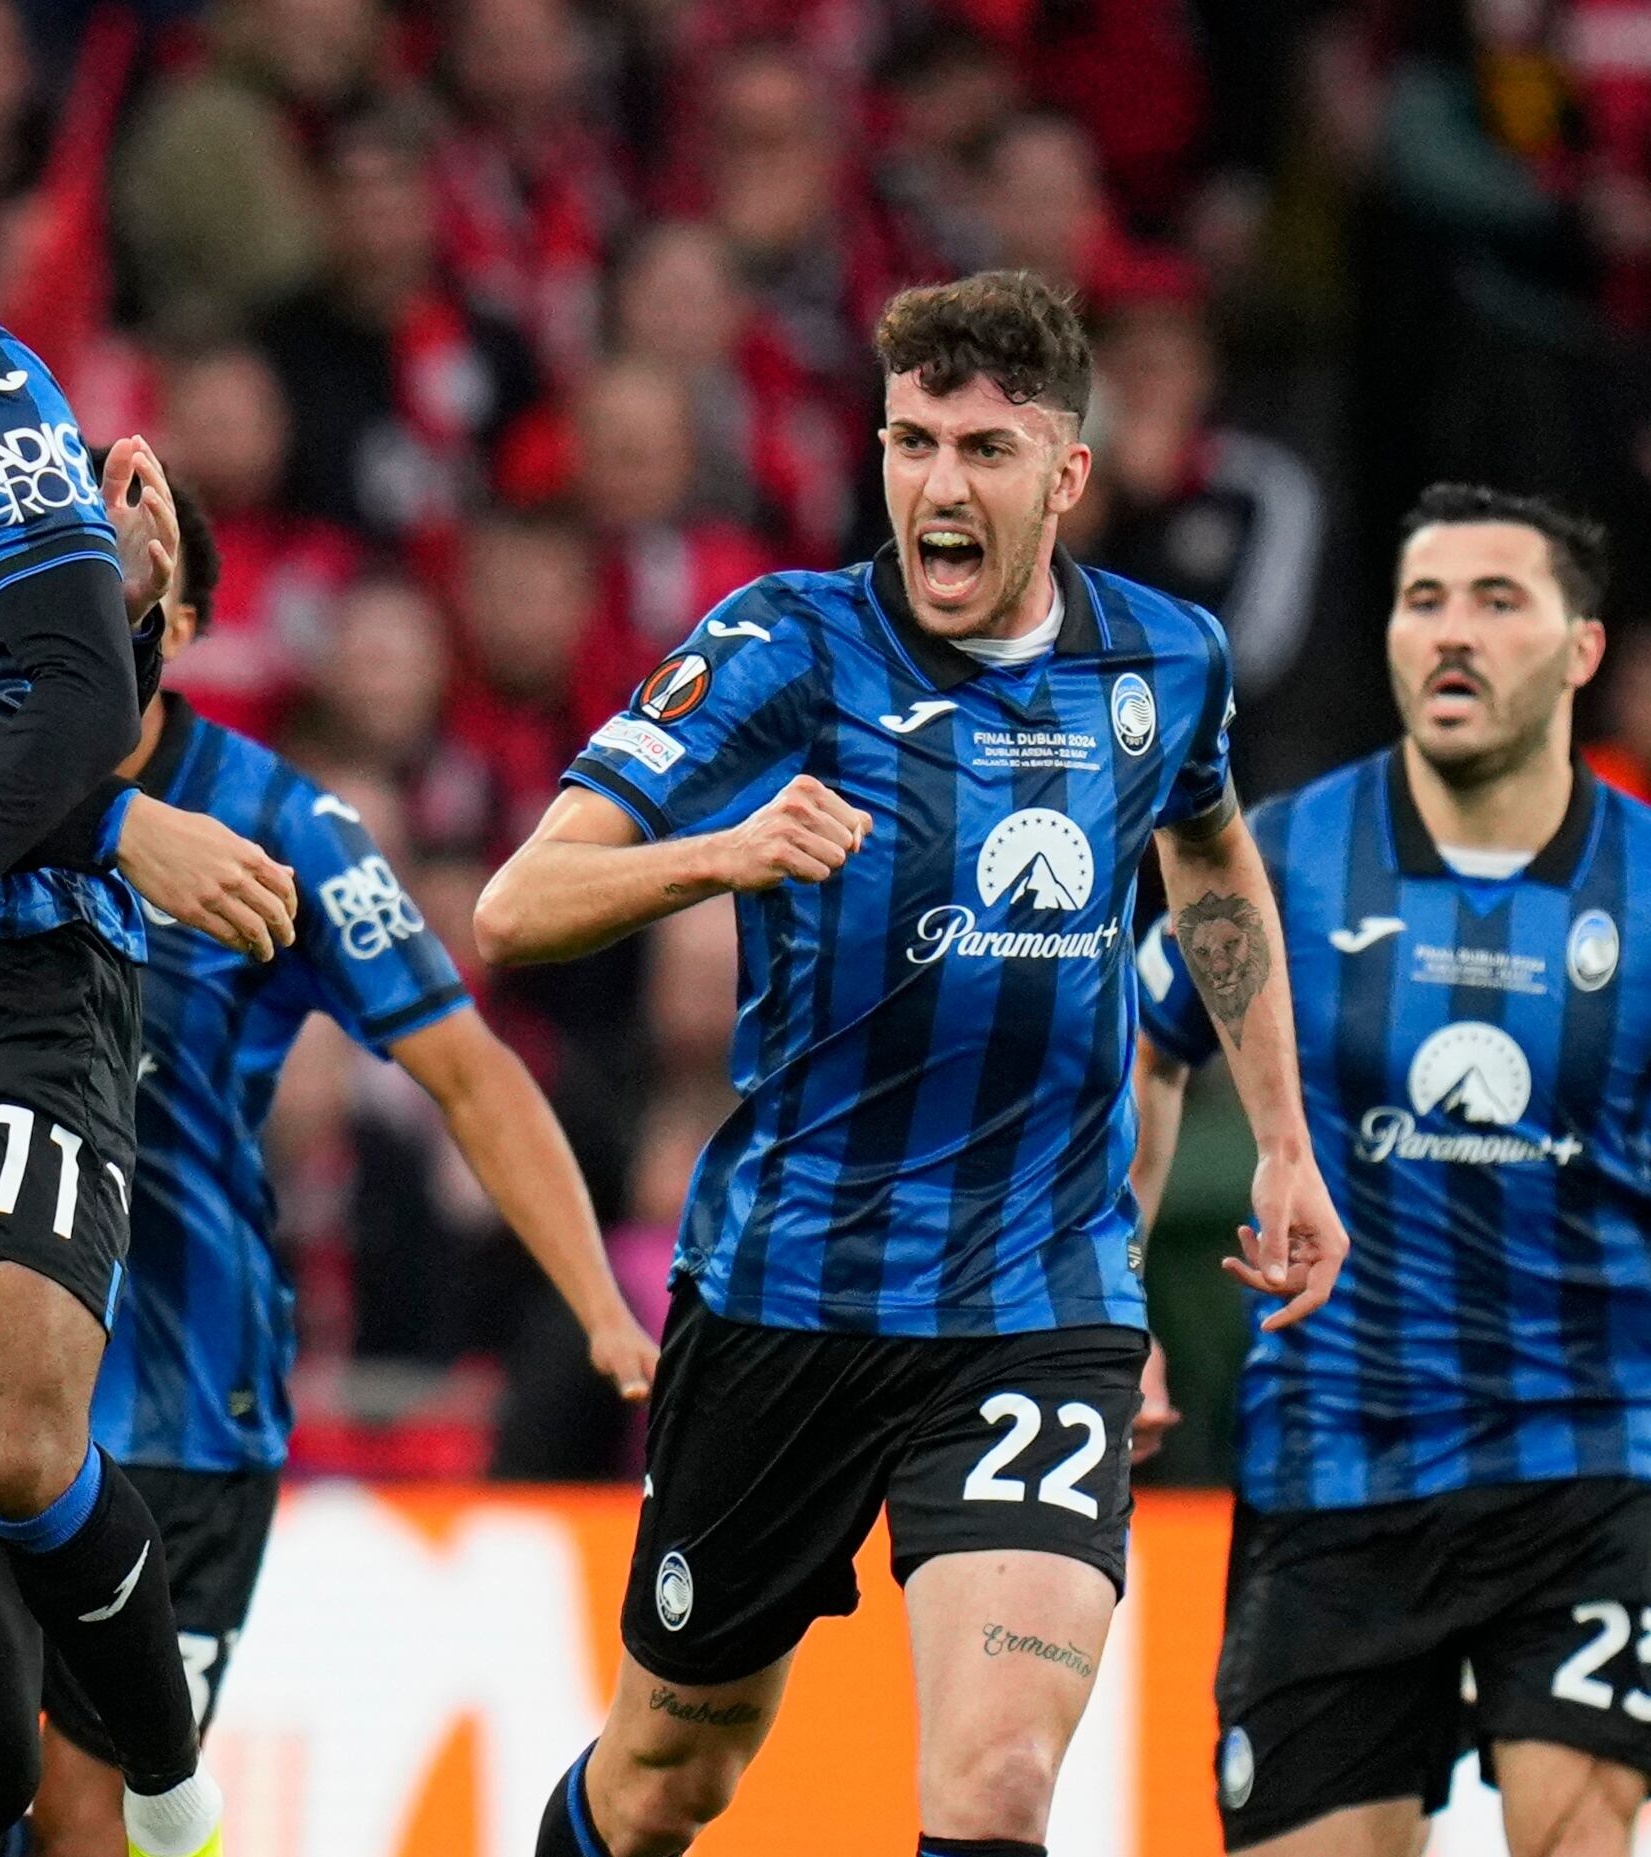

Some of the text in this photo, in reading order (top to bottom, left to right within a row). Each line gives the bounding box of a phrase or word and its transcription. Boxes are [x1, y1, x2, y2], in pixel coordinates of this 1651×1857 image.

[973, 732, 1097, 748] FINAL DUBLIN 2024
[318, 854, 400, 926] RAD
[341, 892, 424, 960] GRO
[906, 904, 1119, 964] Paramount+
[962, 1392, 1107, 1520] 22
